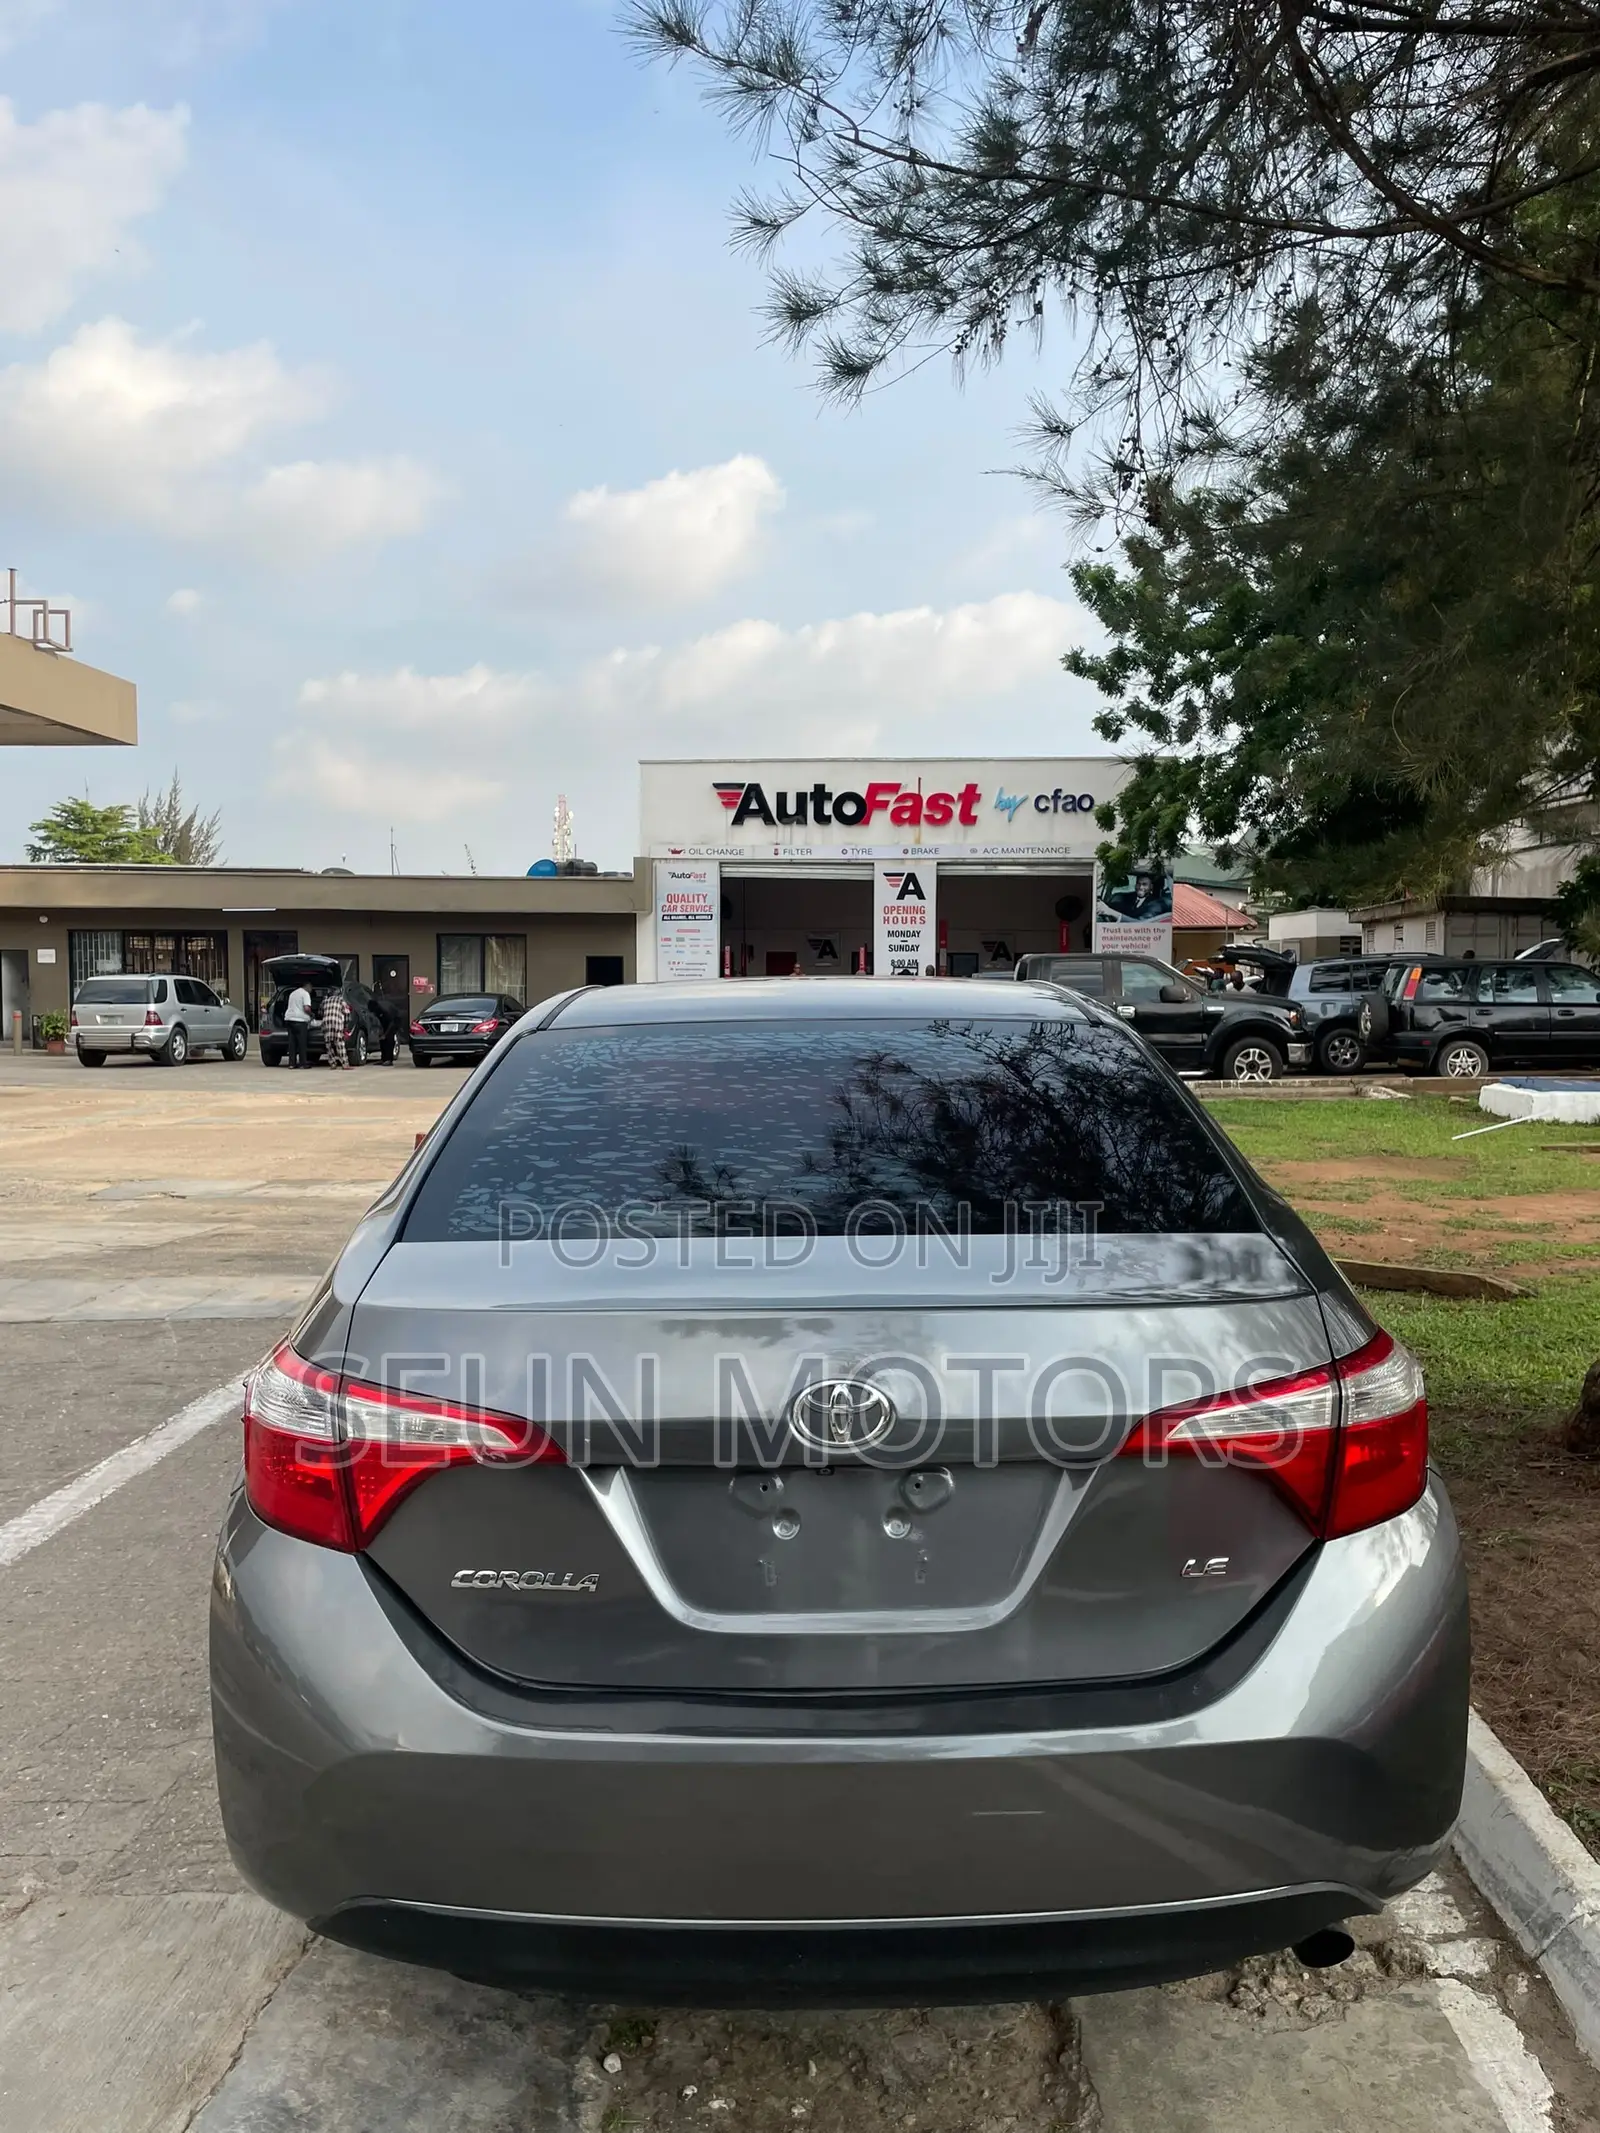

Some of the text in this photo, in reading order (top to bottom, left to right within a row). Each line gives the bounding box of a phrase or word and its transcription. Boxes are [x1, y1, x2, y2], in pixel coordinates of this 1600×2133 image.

[731, 782, 1095, 826] AutoFast by cfao
[688, 848, 745, 856] OIL CHANGE
[783, 848, 813, 856] FILTER
[850, 847, 873, 856] TYRE
[911, 847, 940, 855] BRAKE
[982, 846, 1071, 855] A/C MAINTENANCE
[666, 893, 708, 904] QUALITY
[661, 904, 713, 913] CAR SERVICE
[883, 905, 926, 915] OPENING
[883, 916, 926, 925] HOURS
[887, 930, 921, 938] MONDAY
[888, 944, 920, 952] SUNDAY
[907, 959, 918, 967] AM
[1181, 1557, 1229, 1577] LE
[451, 1569, 599, 1592] COROLLA
